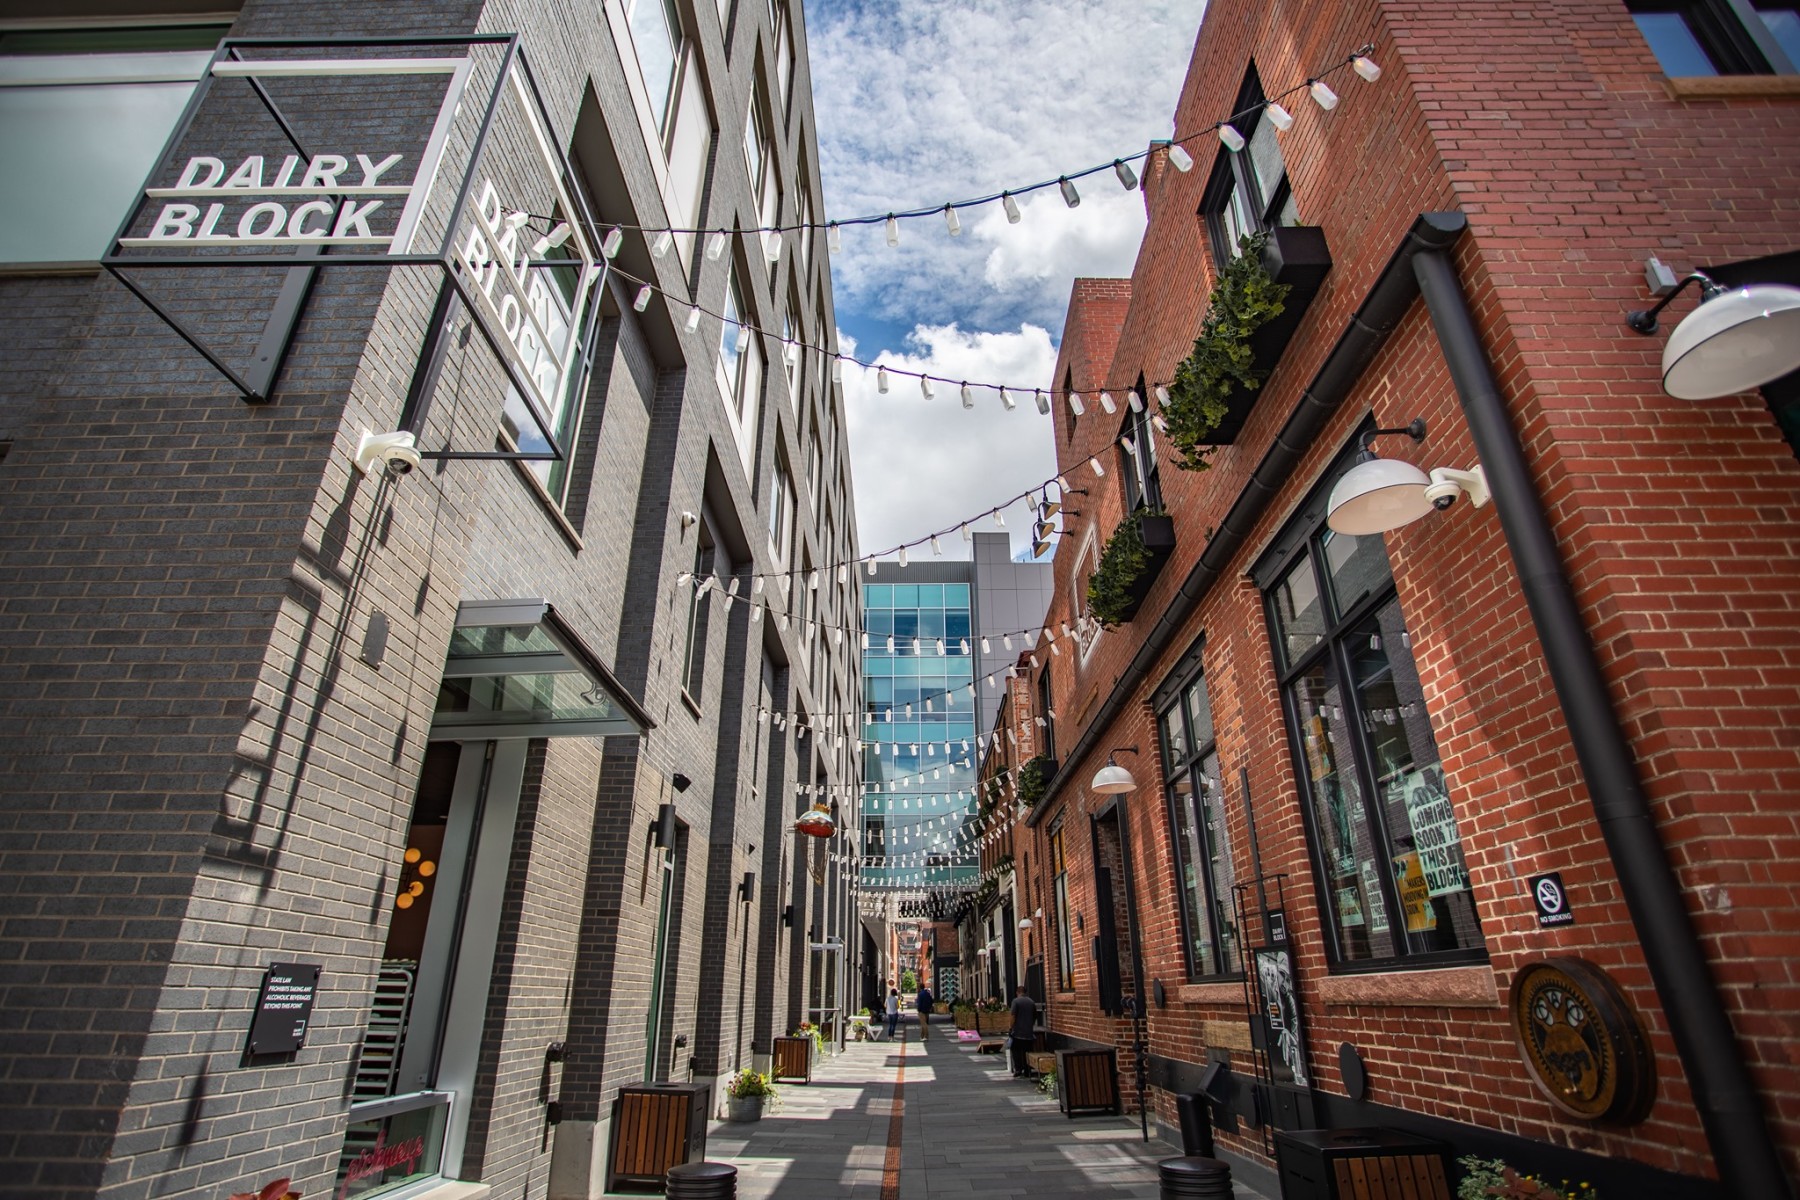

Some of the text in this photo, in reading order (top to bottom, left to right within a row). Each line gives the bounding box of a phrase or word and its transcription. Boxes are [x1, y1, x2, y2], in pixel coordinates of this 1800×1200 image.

[175, 154, 404, 188] DAIRY
[149, 200, 385, 239] BLOCK
[477, 177, 562, 338] DAIRY
[464, 223, 558, 394] BLOCK
[1412, 800, 1453, 830] COMING
[1415, 825, 1446, 851] SOON
[1419, 846, 1448, 870] THIS
[1426, 864, 1461, 892] BLOCK
[1547, 913, 1572, 922] SMOKING
